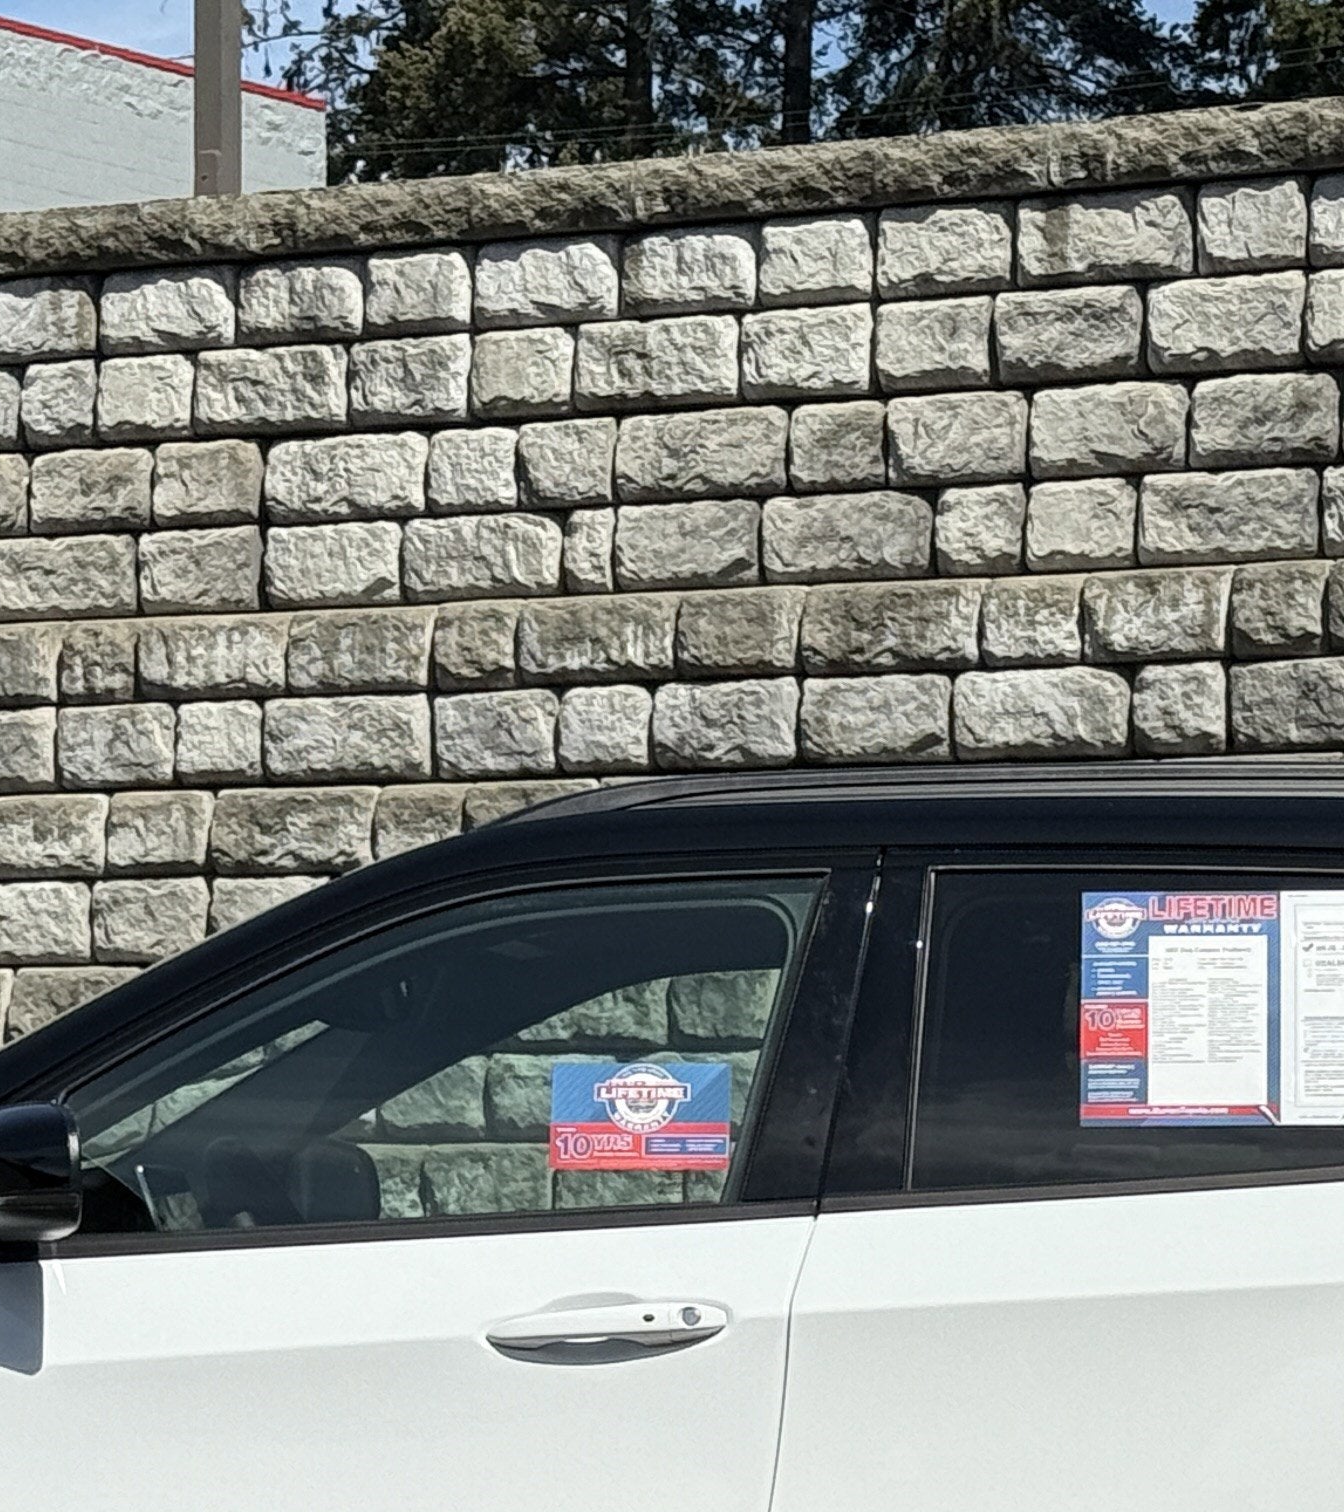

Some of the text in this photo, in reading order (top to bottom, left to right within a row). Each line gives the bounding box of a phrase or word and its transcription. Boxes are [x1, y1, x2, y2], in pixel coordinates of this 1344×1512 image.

[1149, 894, 1278, 921] LIFETIME
[1163, 922, 1263, 934] WARRANTY
[1086, 1009, 1116, 1031] 10
[600, 1086, 686, 1099] LIFETIME
[556, 1132, 592, 1160] 10
[593, 1133, 634, 1151] YRS
